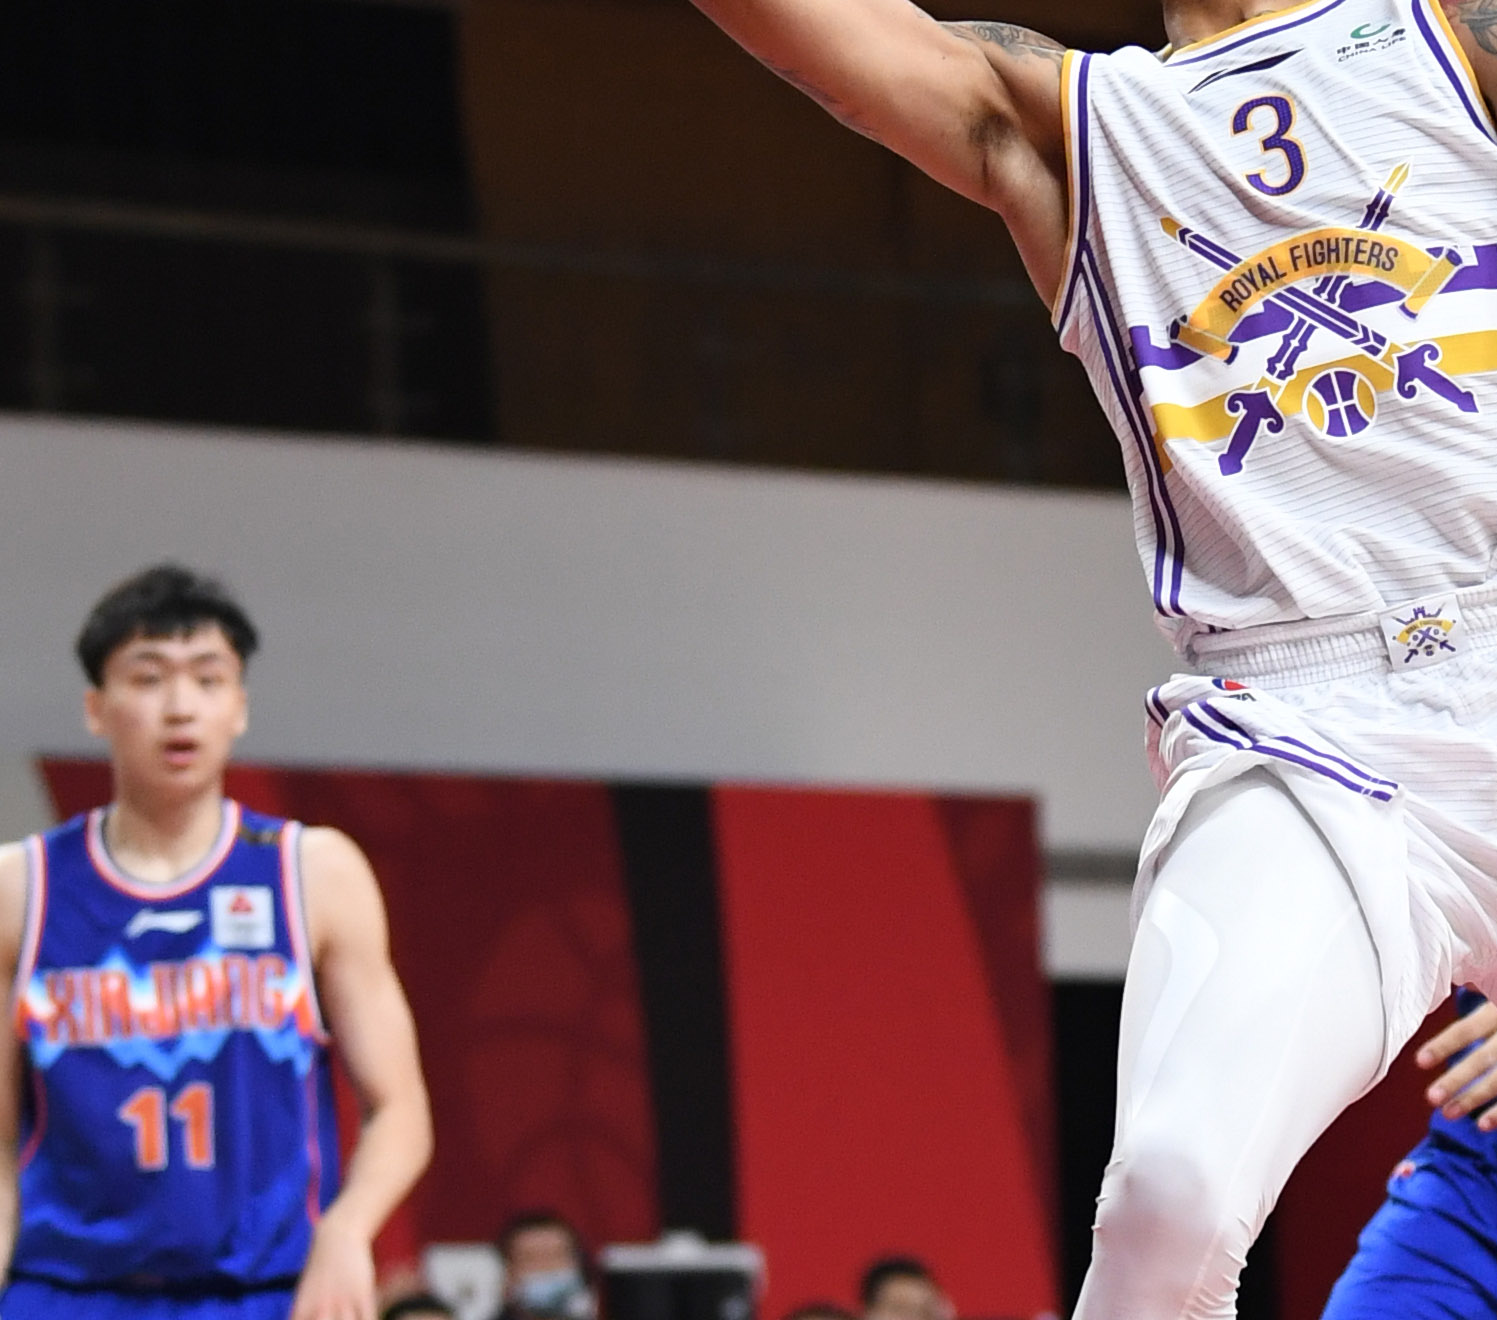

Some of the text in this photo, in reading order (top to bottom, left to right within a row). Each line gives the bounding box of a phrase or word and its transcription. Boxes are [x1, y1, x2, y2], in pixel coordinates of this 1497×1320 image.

[1229, 92, 1309, 198] 3
[1219, 237, 1399, 314] ROYAL FIGHTERS
[117, 1082, 215, 1172] 11
